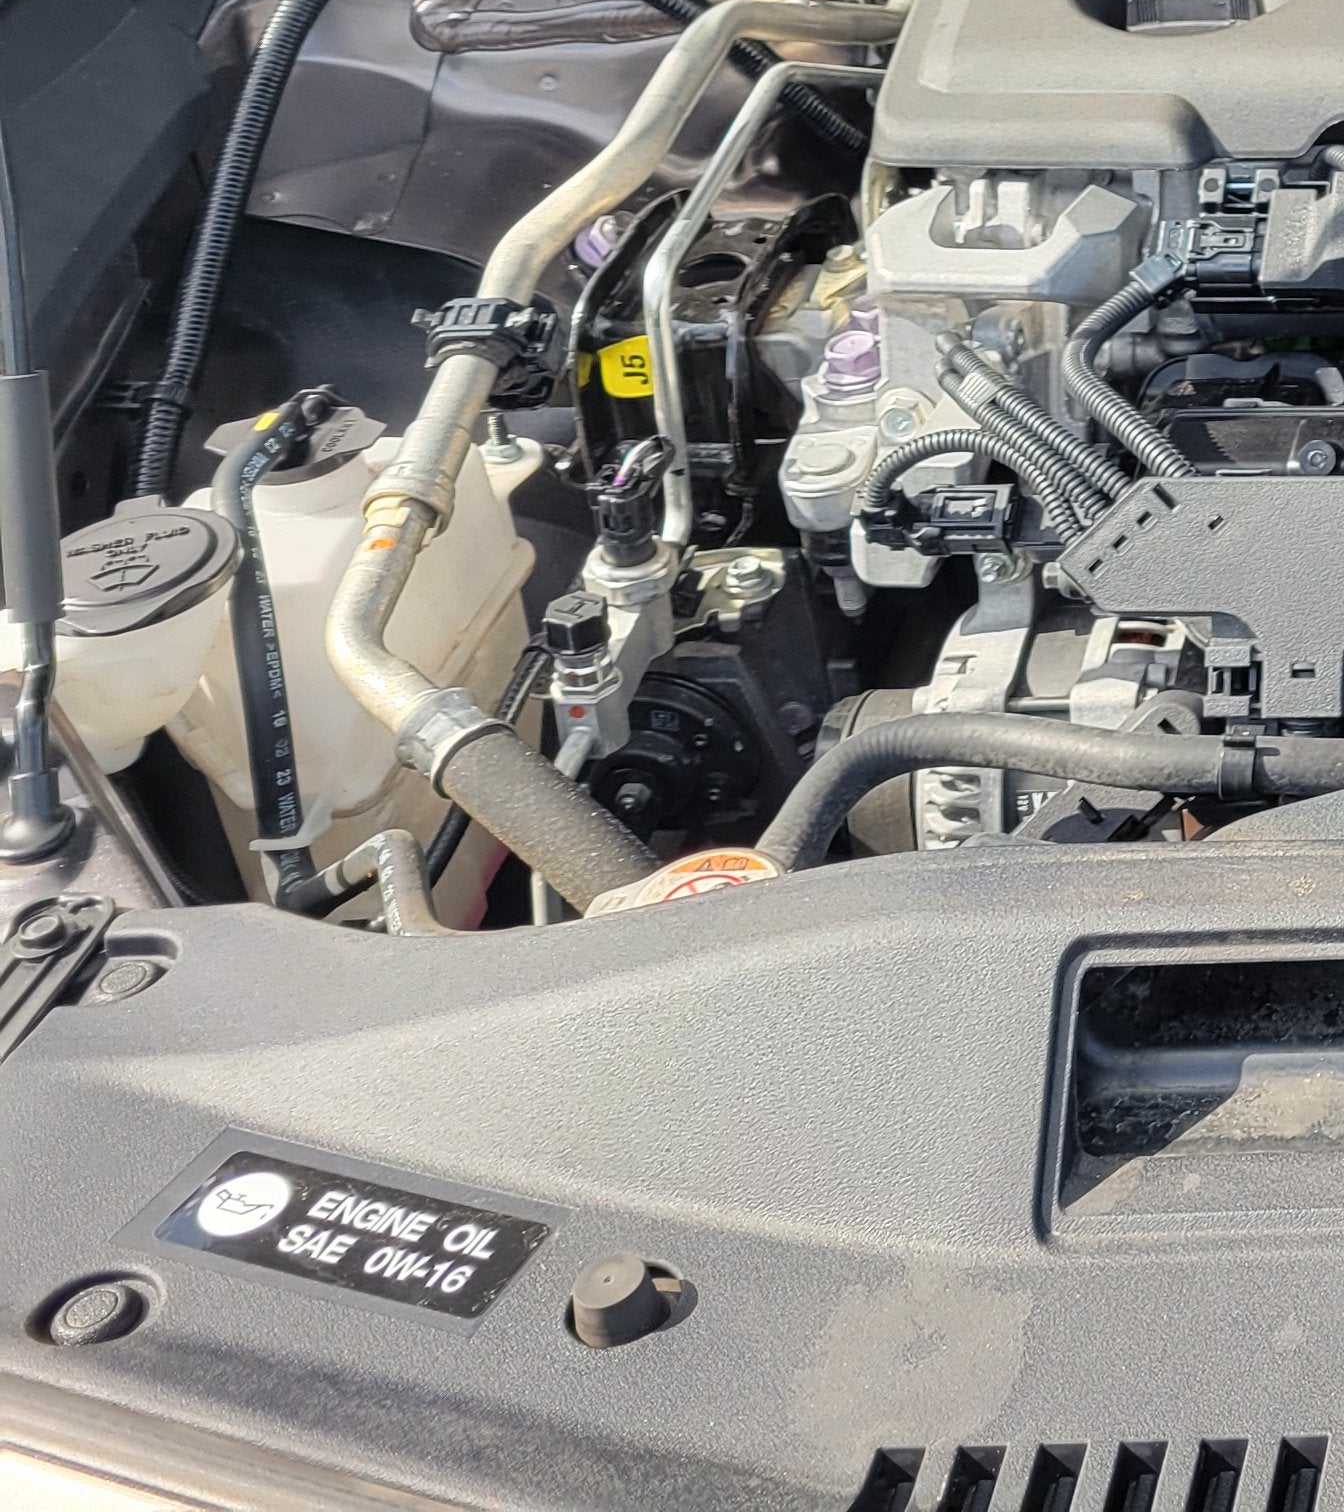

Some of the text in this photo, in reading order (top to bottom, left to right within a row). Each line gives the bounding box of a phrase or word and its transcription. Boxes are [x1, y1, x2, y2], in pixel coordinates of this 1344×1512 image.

[620, 355, 649, 385] J5
[257, 594, 276, 639] WATER
[276, 768, 293, 787] 23
[277, 791, 298, 834] WATER
[306, 1190, 500, 1260] ENGINE OIL
[276, 1224, 477, 1293] SAE 0W-16
